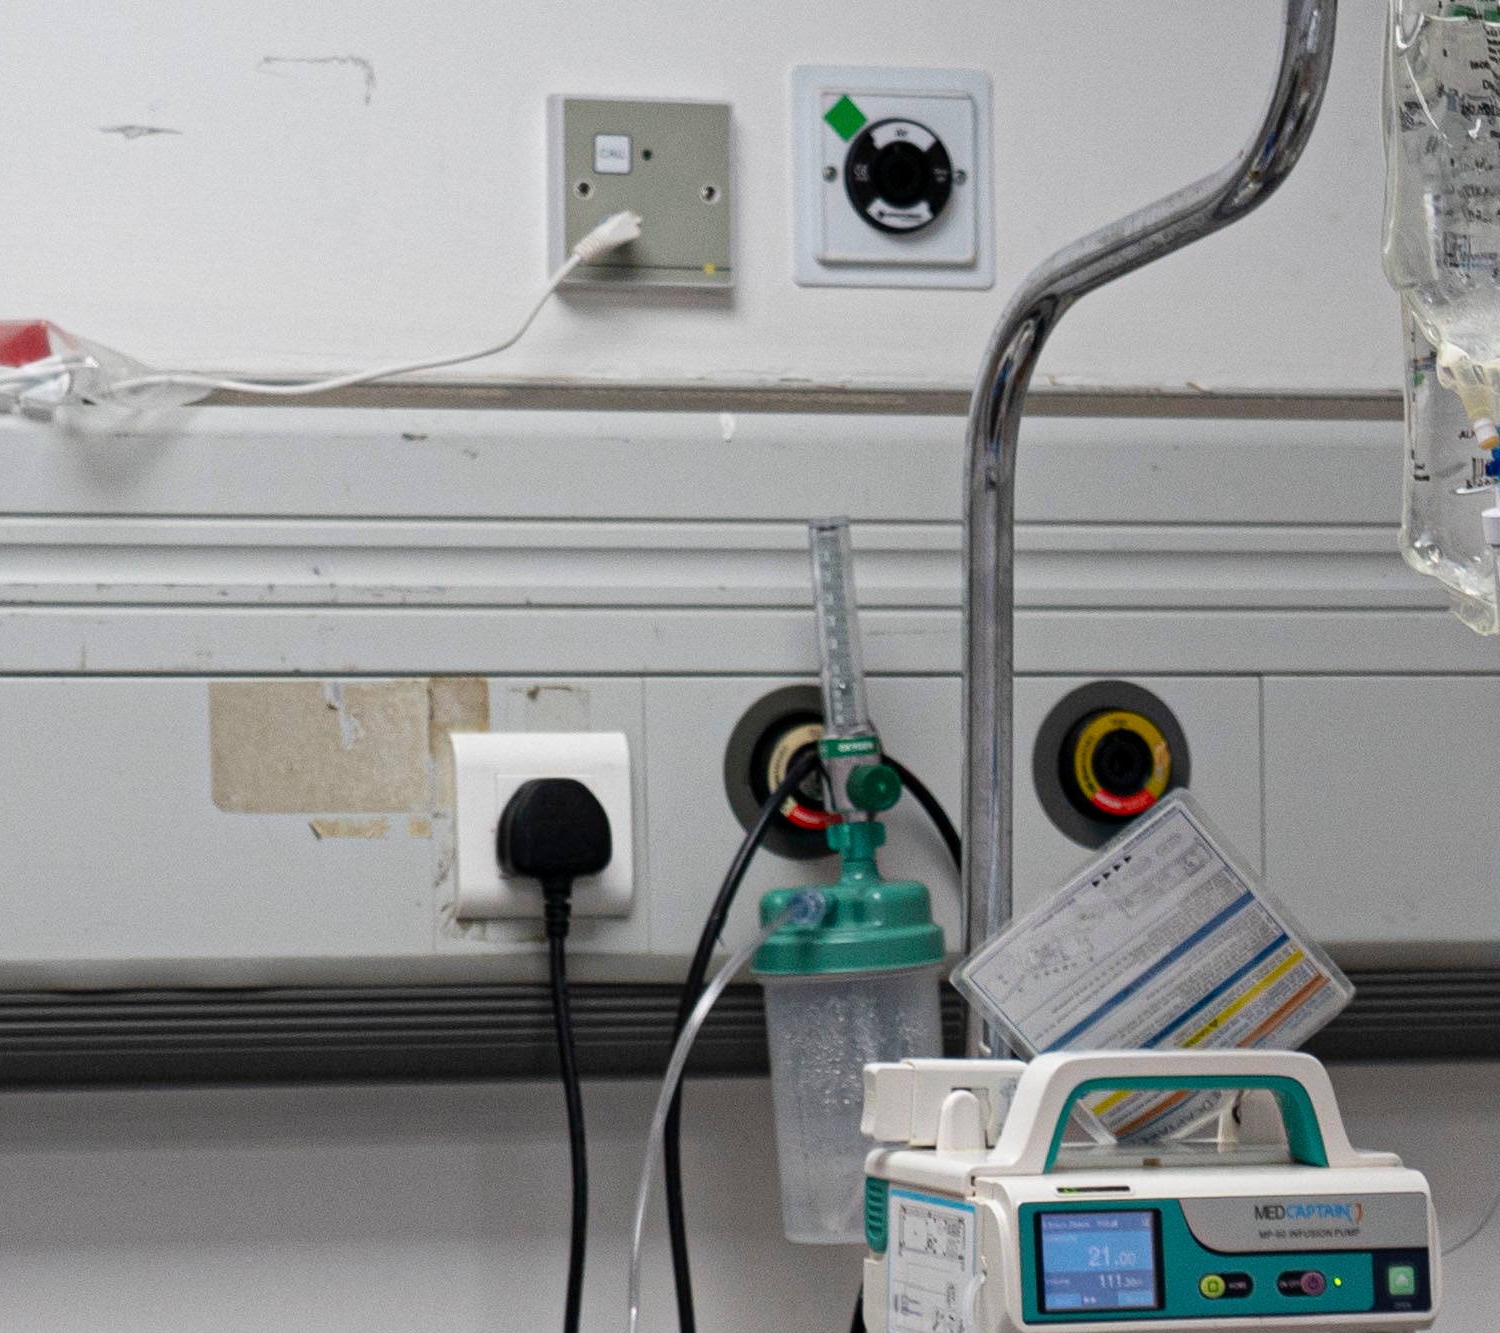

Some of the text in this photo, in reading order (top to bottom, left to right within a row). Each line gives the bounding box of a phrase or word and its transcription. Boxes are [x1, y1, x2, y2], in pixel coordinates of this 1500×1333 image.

[1254, 1202, 1356, 1222] MEDCAPTAIN
[1288, 1228, 1333, 1240] INFUSION
[1334, 1227, 1361, 1238] PUMP
